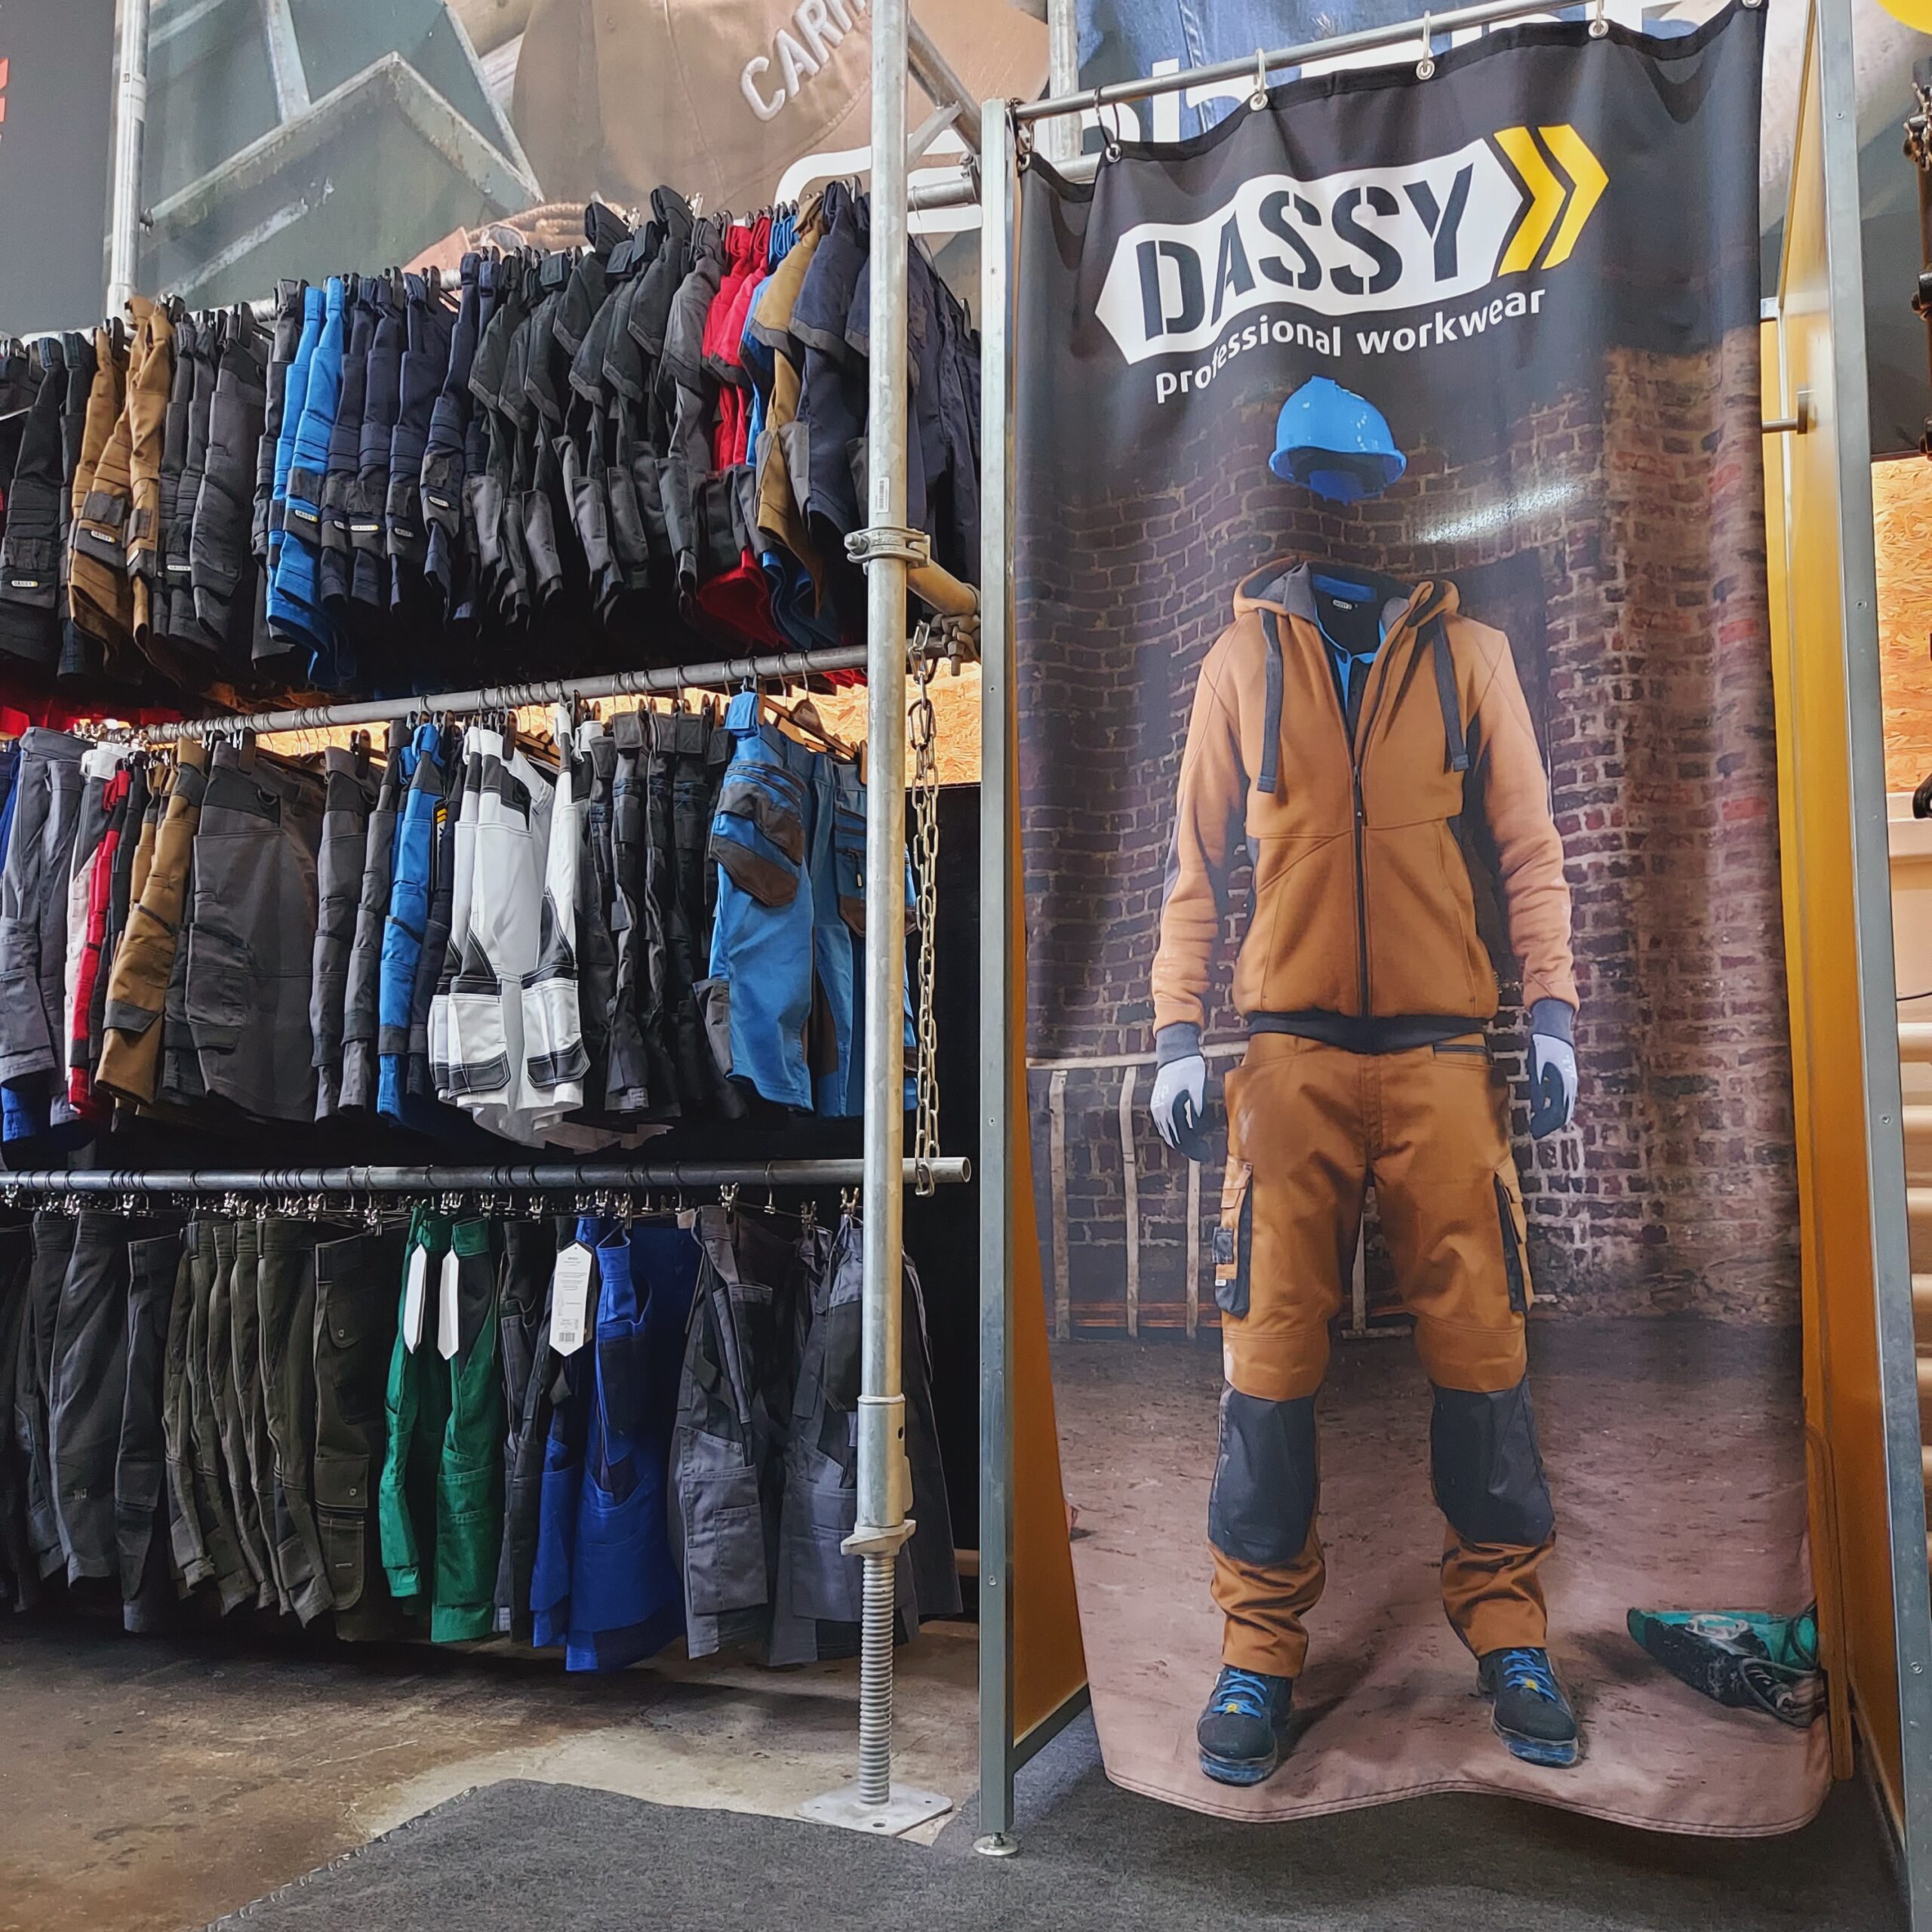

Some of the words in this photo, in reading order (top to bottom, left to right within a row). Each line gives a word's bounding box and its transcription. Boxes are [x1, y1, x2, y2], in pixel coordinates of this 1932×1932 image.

[740, 0, 867, 122] CAR
[1136, 162, 1474, 342] DASSY
[1155, 314, 1341, 404] professional
[1356, 289, 1546, 355] workwear
